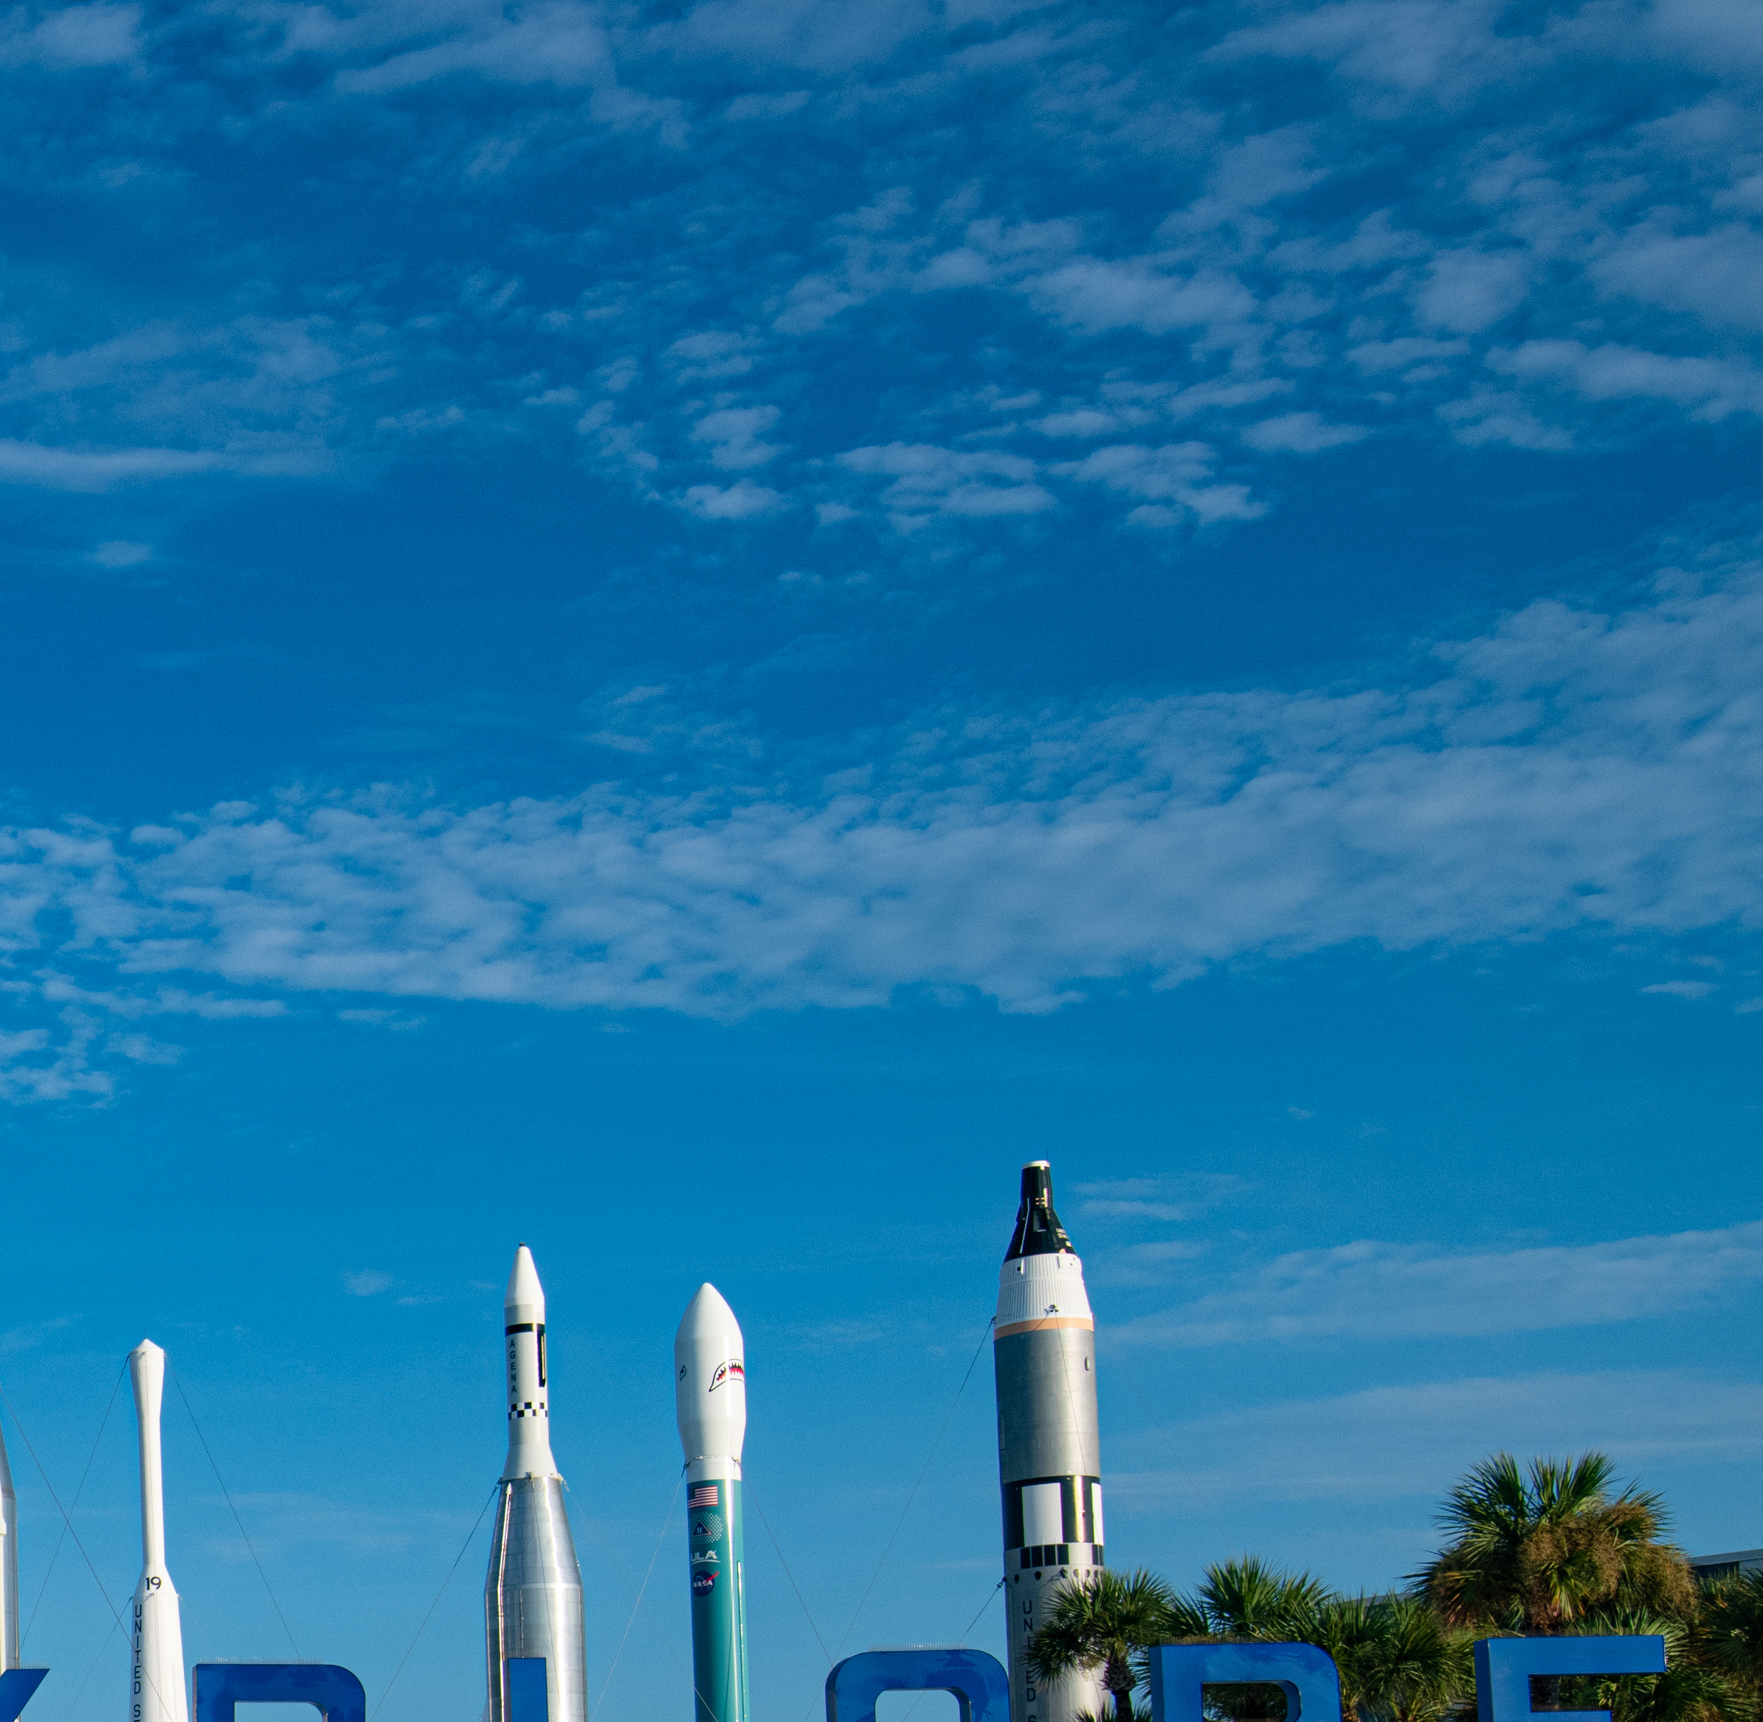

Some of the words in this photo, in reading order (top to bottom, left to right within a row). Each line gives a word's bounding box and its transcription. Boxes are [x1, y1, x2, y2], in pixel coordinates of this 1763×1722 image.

[509, 1338, 518, 1394] AGENA
[690, 1549, 718, 1561] ULA
[145, 1576, 162, 1591] 19
[132, 1604, 142, 1695] UNITED
